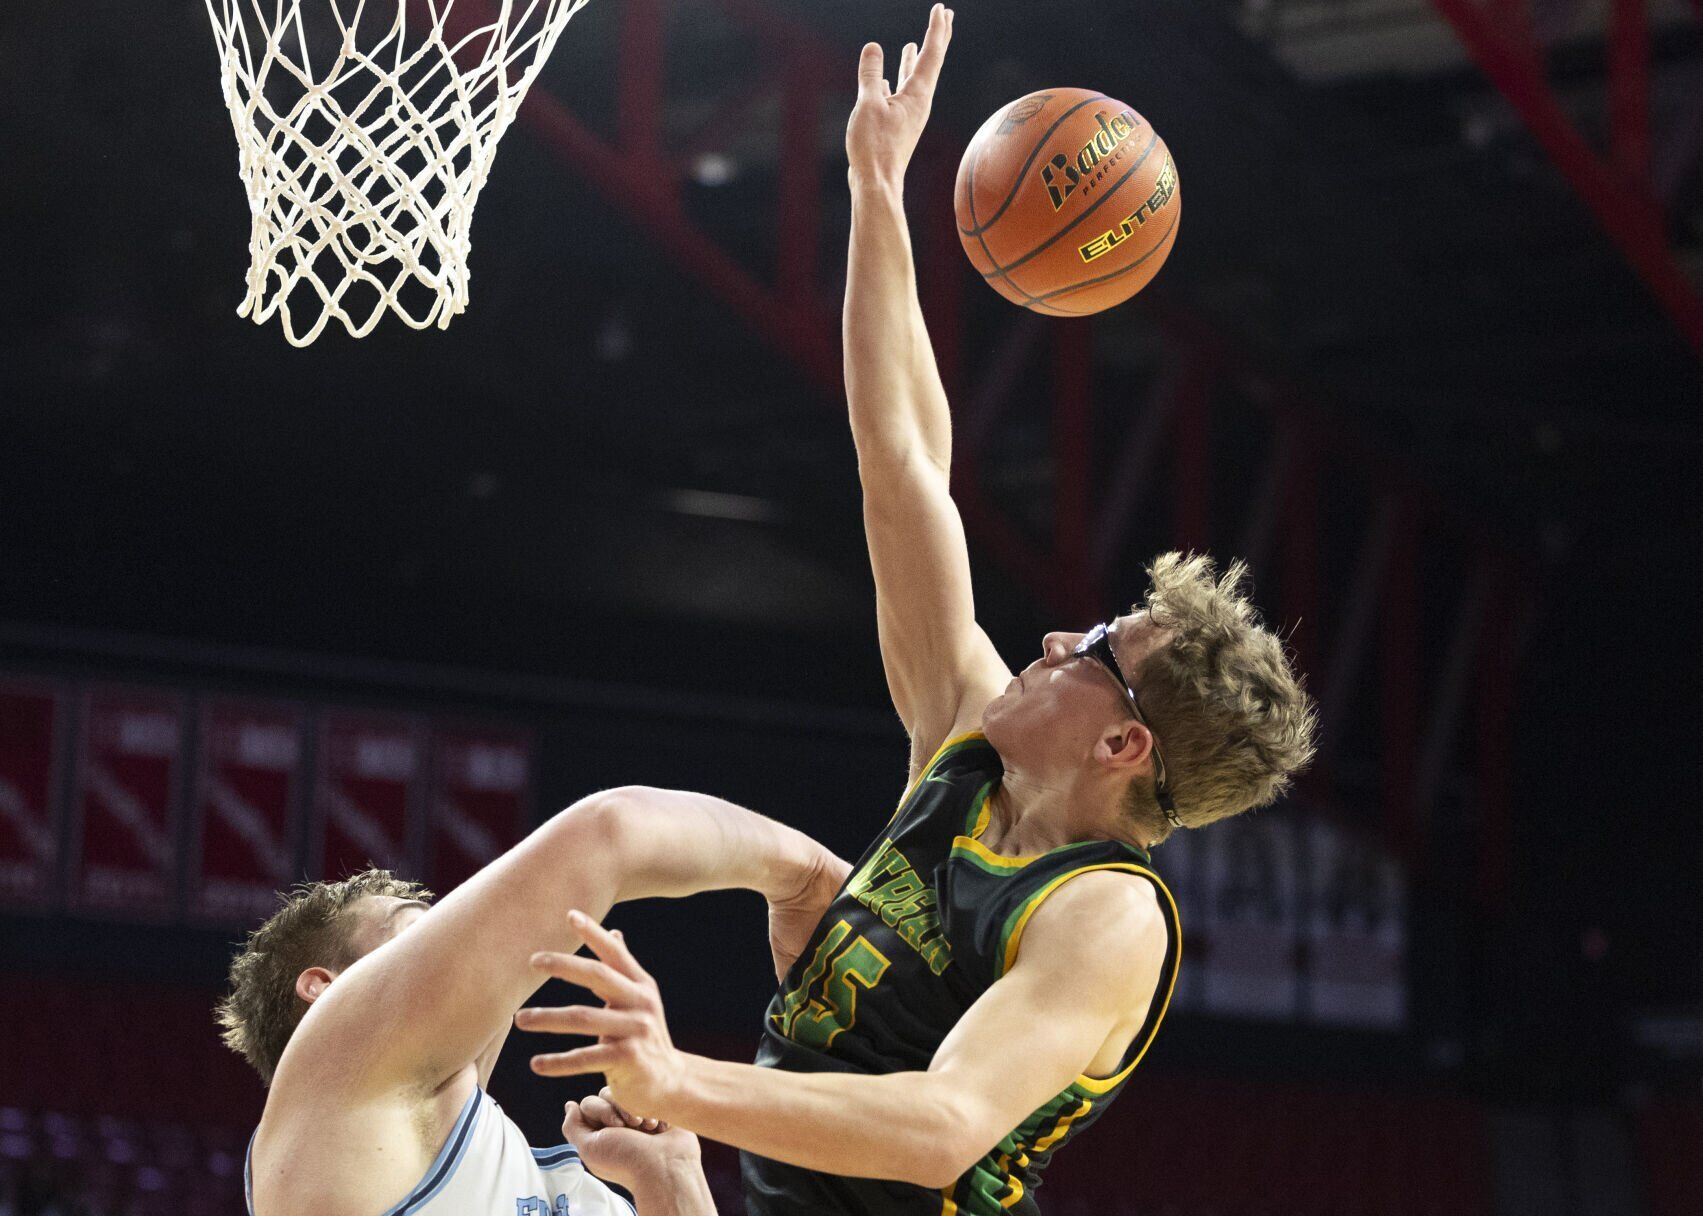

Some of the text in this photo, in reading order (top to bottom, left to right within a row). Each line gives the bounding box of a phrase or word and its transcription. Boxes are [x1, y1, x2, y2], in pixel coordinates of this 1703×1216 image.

[1040, 110, 1141, 213] Baden
[1078, 187, 1166, 263] ELITE
[770, 919, 892, 1048] 15
